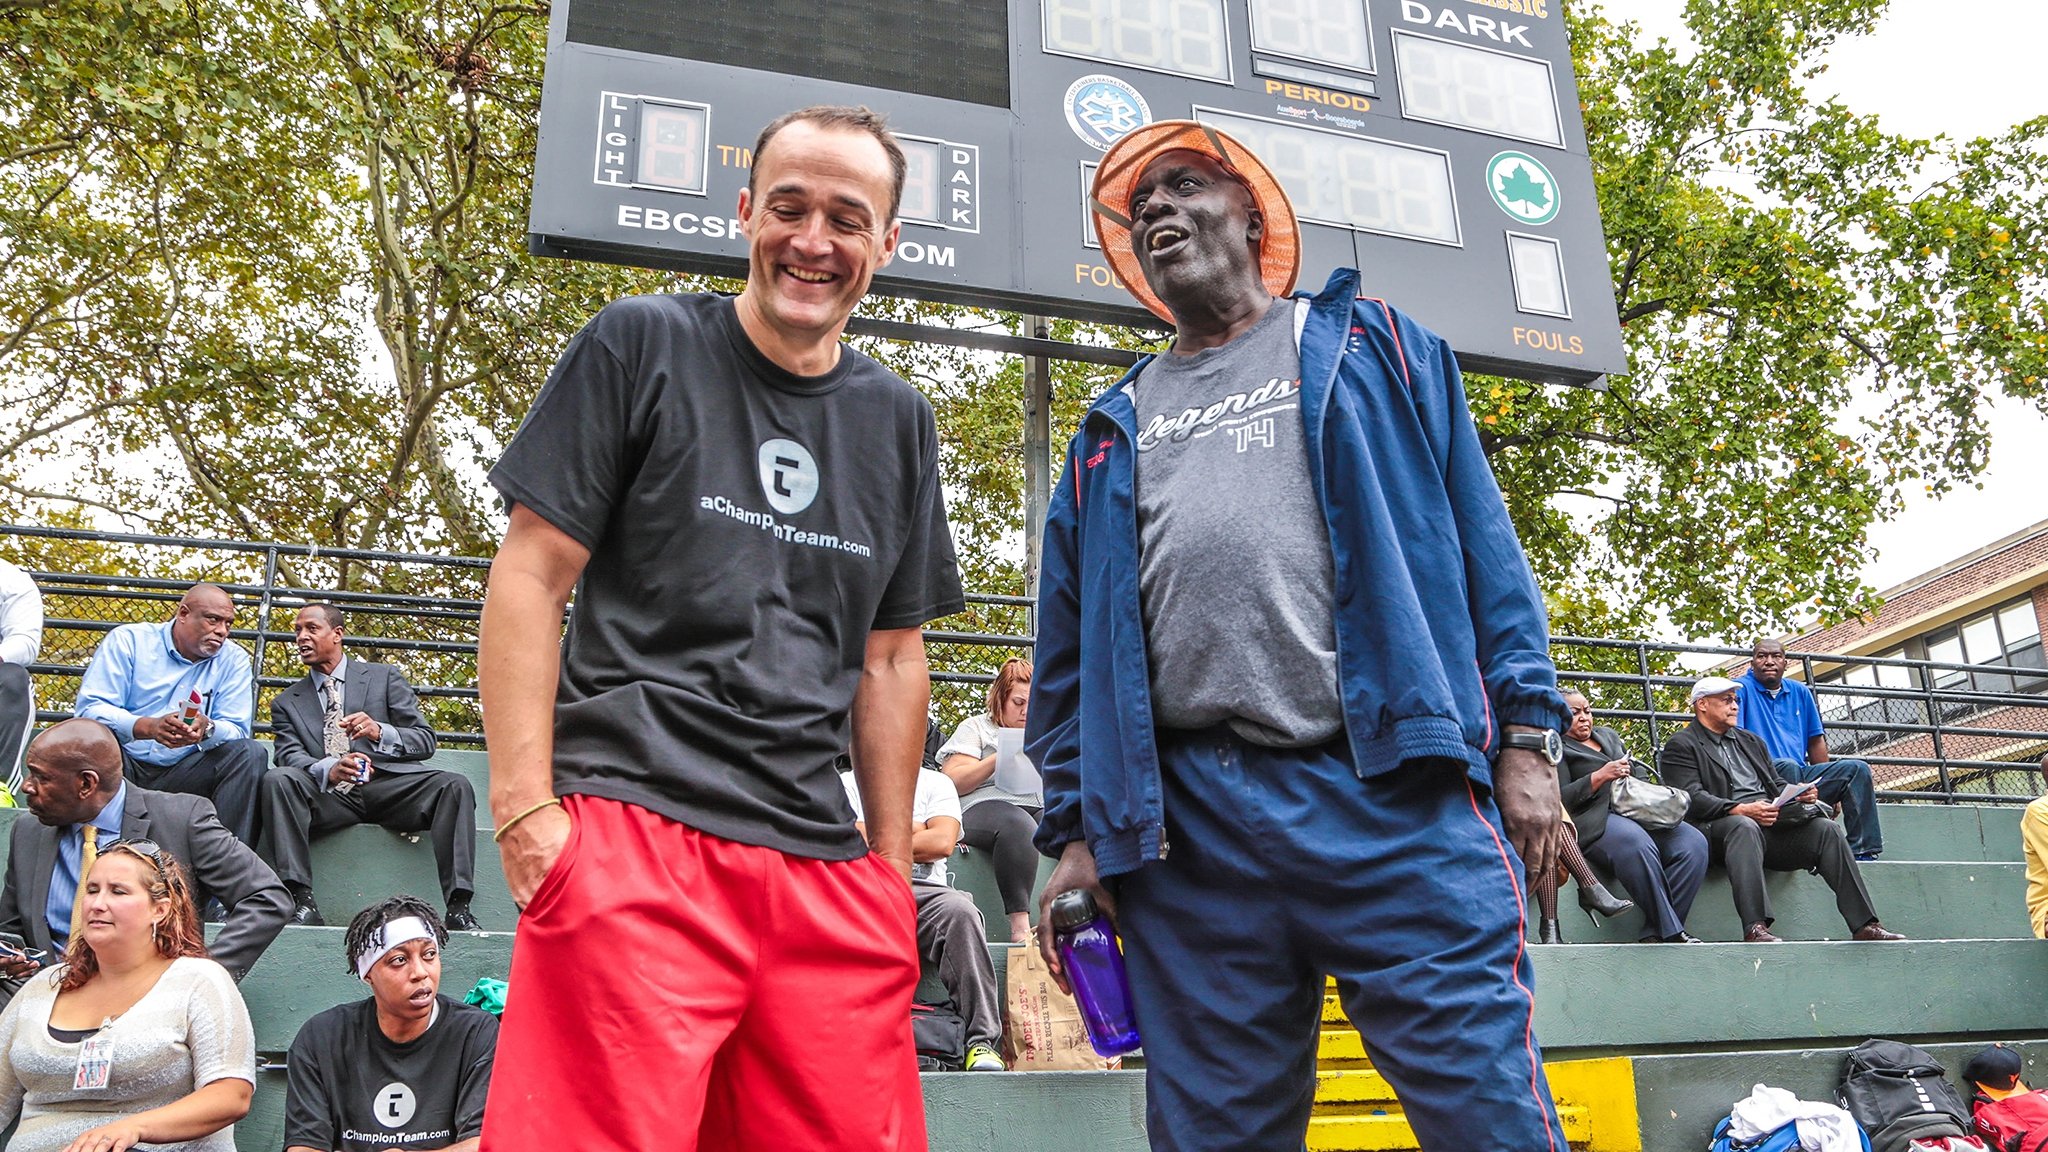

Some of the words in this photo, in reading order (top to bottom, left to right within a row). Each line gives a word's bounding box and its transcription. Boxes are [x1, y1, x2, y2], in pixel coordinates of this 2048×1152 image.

[1401, 0, 1533, 48] DARK
[1265, 79, 1371, 112] PERIOD
[604, 96, 628, 183] LIGHT
[951, 149, 972, 225] DARK
[1075, 263, 1127, 289] FOU
[1512, 327, 1584, 355] FOULS
[1136, 377, 1301, 452] Legends
[1023, 1020, 1035, 1062] TRADER
[1043, 1011, 1052, 1037] RECYCLE
